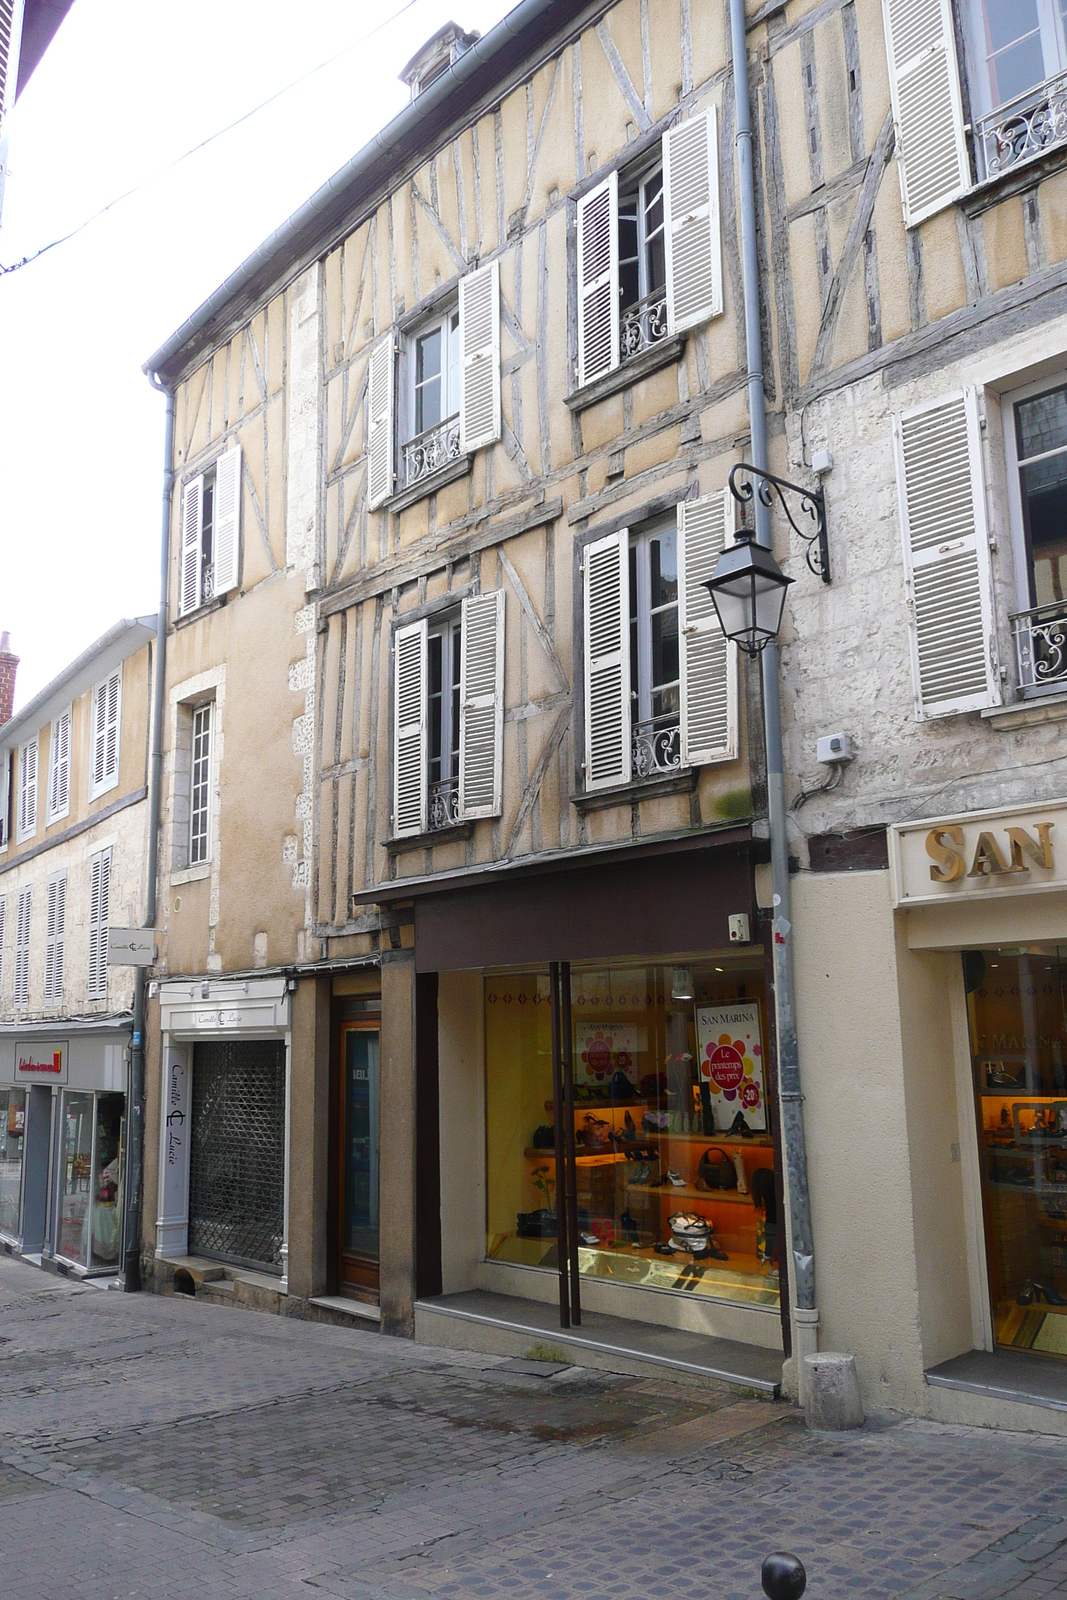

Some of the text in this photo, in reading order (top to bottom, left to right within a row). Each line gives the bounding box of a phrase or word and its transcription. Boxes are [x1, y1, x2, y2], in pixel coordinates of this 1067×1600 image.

[925, 822, 1055, 883] SAN
[198, 1013, 216, 1023] Camille
[702, 1012, 755, 1026] SAN MARINA
[721, 1049, 730, 1058] Le
[712, 1061, 742, 1073] printemps
[715, 1070, 739, 1082] des prix
[171, 1065, 184, 1106] Camille
[169, 1132, 181, 1165] Lucie
